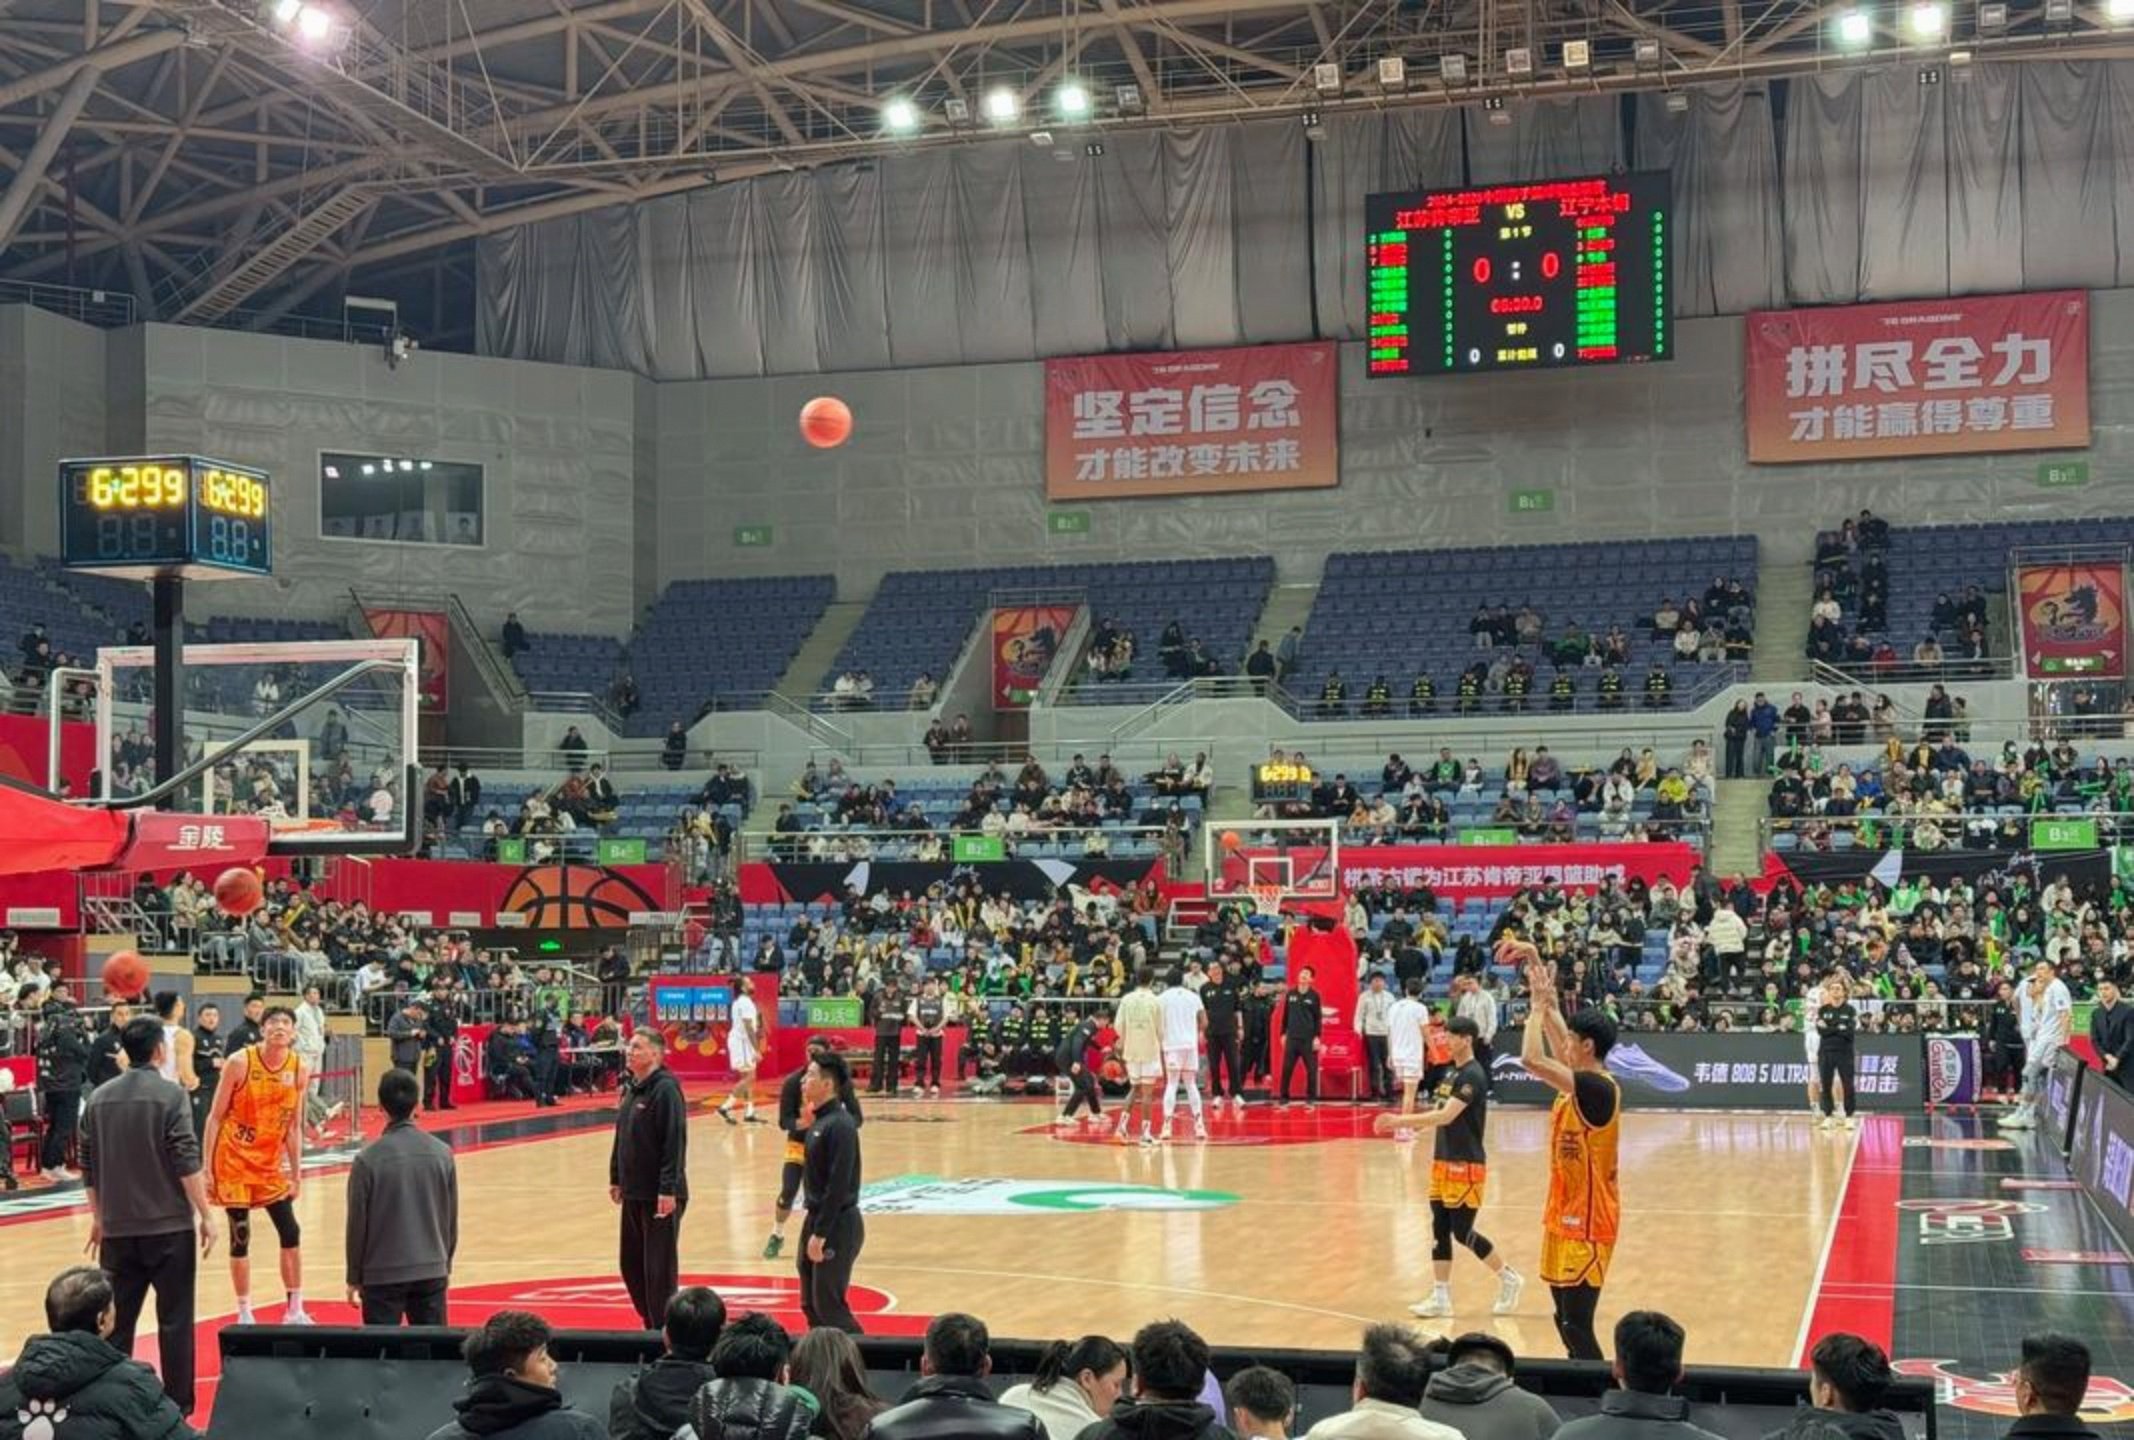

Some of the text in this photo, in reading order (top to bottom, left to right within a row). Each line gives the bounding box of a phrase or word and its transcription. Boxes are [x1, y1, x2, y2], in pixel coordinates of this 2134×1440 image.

[1506, 203, 1525, 219] VS
[1473, 252, 1559, 283] 0 0
[1469, 348, 1480, 364] 0
[1553, 343, 1565, 358] 0
[1786, 333, 2052, 397] 拼尽全力
[1073, 380, 1300, 438] 坚定信念
[1790, 394, 2054, 441] 才能赢得尊重
[1075, 439, 1299, 481] 才能改变未来
[170, 825, 232, 850] 金陵
[1694, 1063, 1727, 1083] 韦德
[1771, 1064, 1809, 1083] ULTRA
